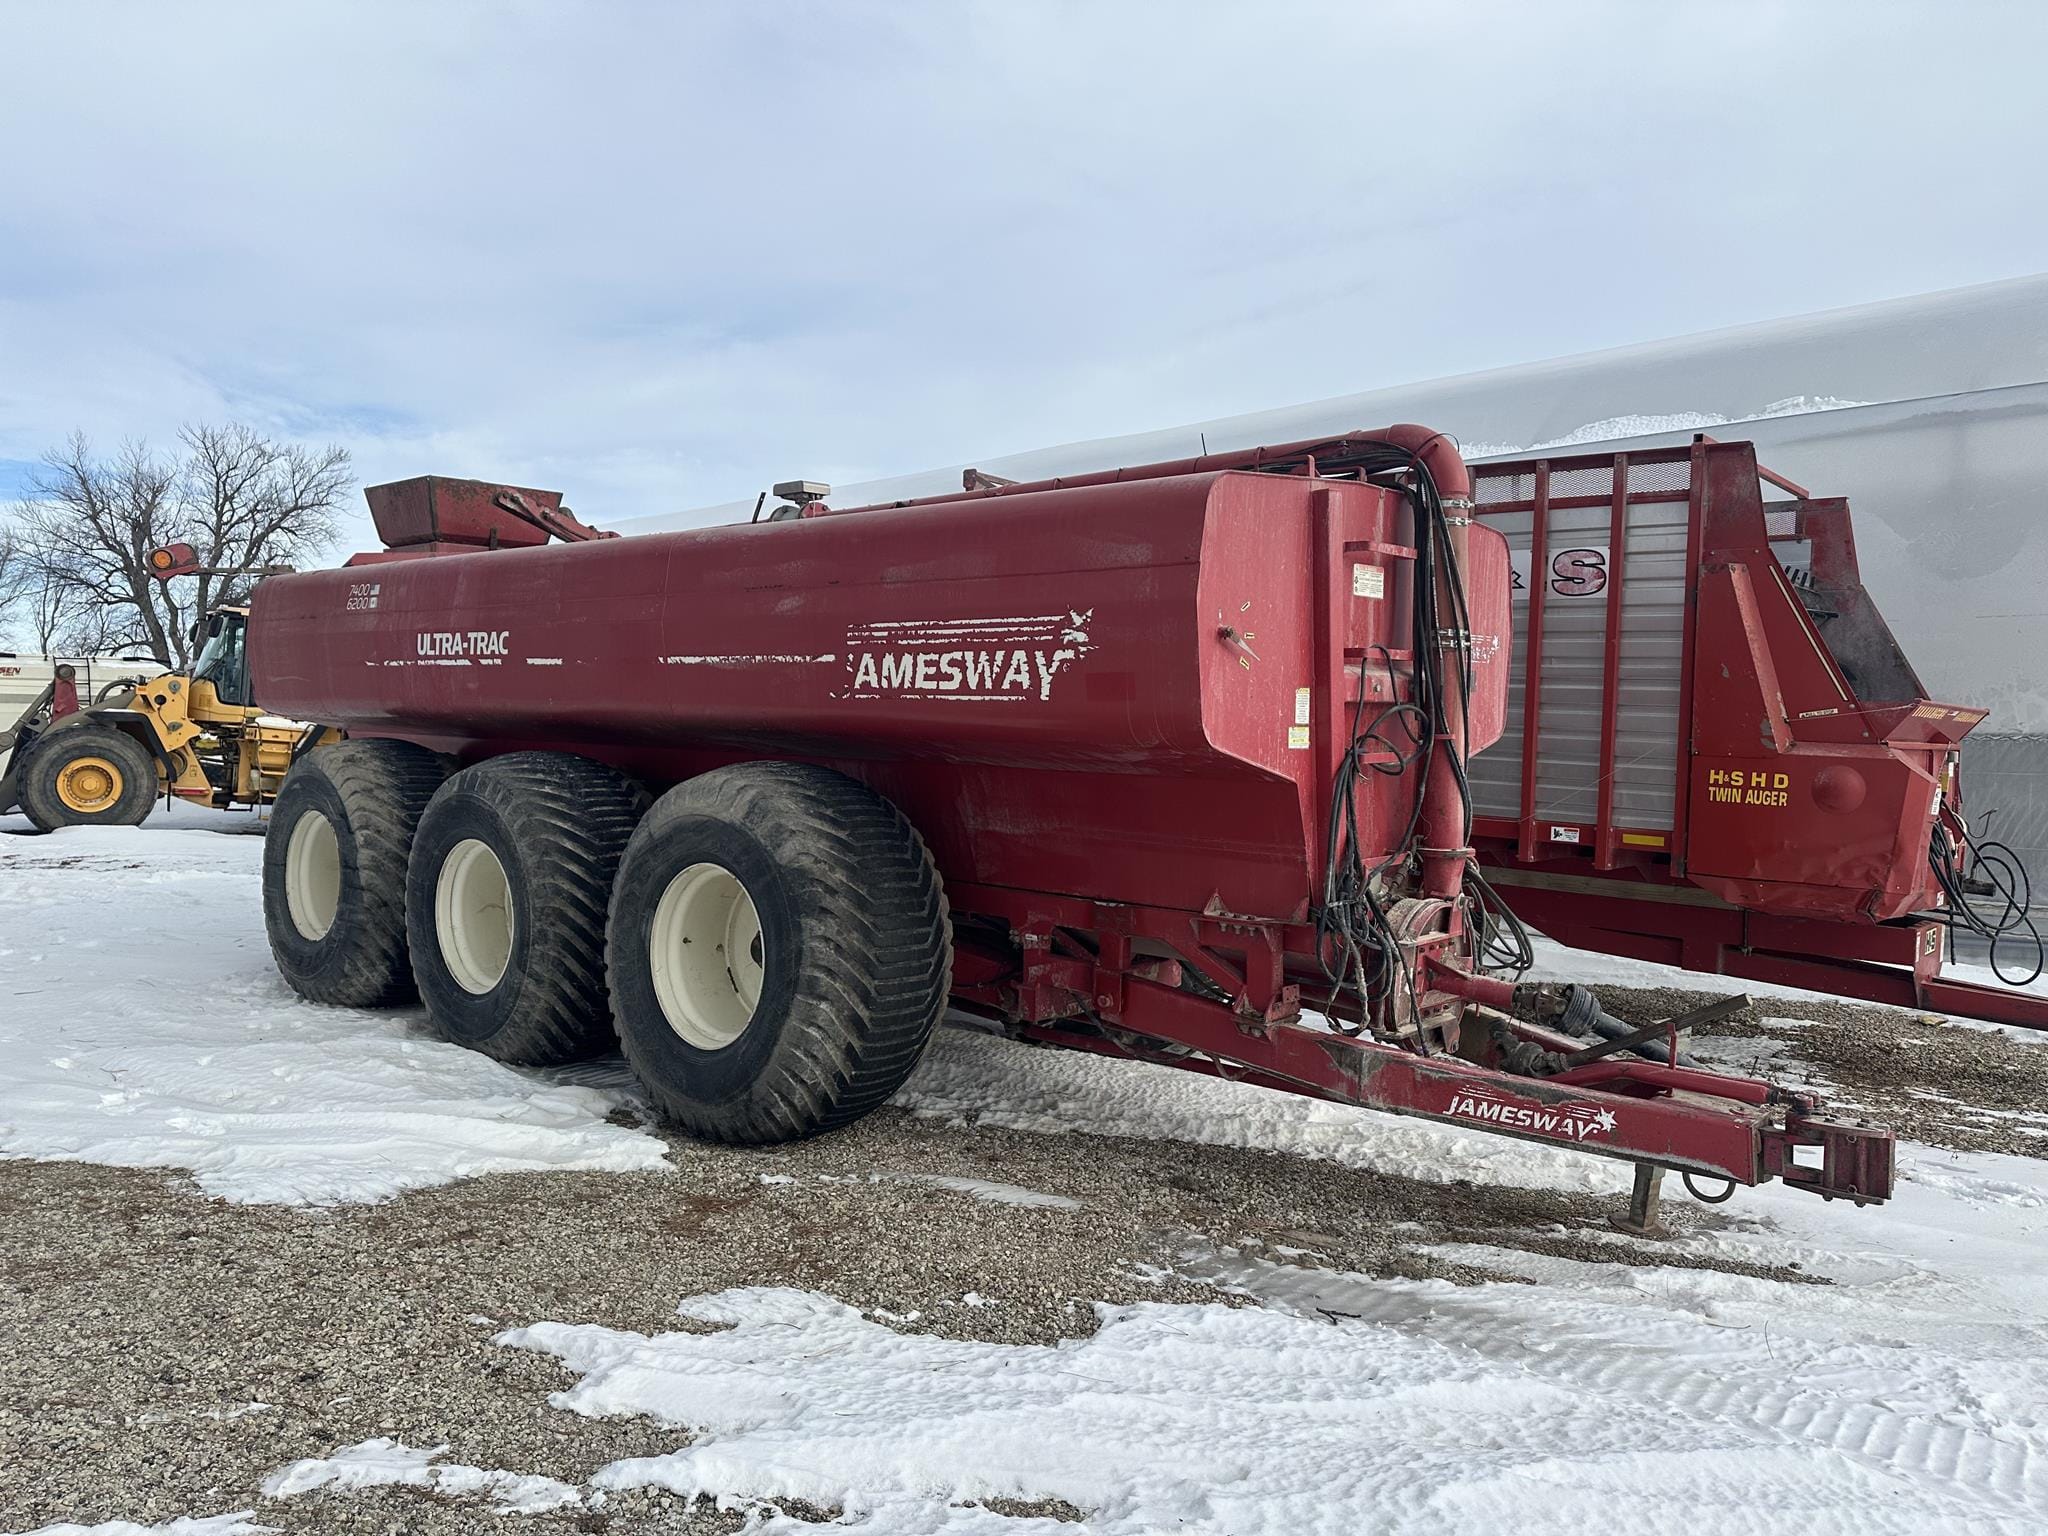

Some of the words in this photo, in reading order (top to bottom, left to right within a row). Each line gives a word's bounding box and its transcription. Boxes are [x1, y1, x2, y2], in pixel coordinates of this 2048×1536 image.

[349, 583, 371, 597] 7400
[346, 597, 369, 610] 6200
[417, 631, 510, 656] ULTRA-TRAC
[842, 650, 1075, 700] AMESWAY
[1751, 772, 1767, 787] H
[1773, 773, 1789, 789] D
[1708, 786, 1742, 803] TWIN
[1745, 789, 1788, 807] AUGER
[1442, 1095, 1602, 1142] JAMESWAY
